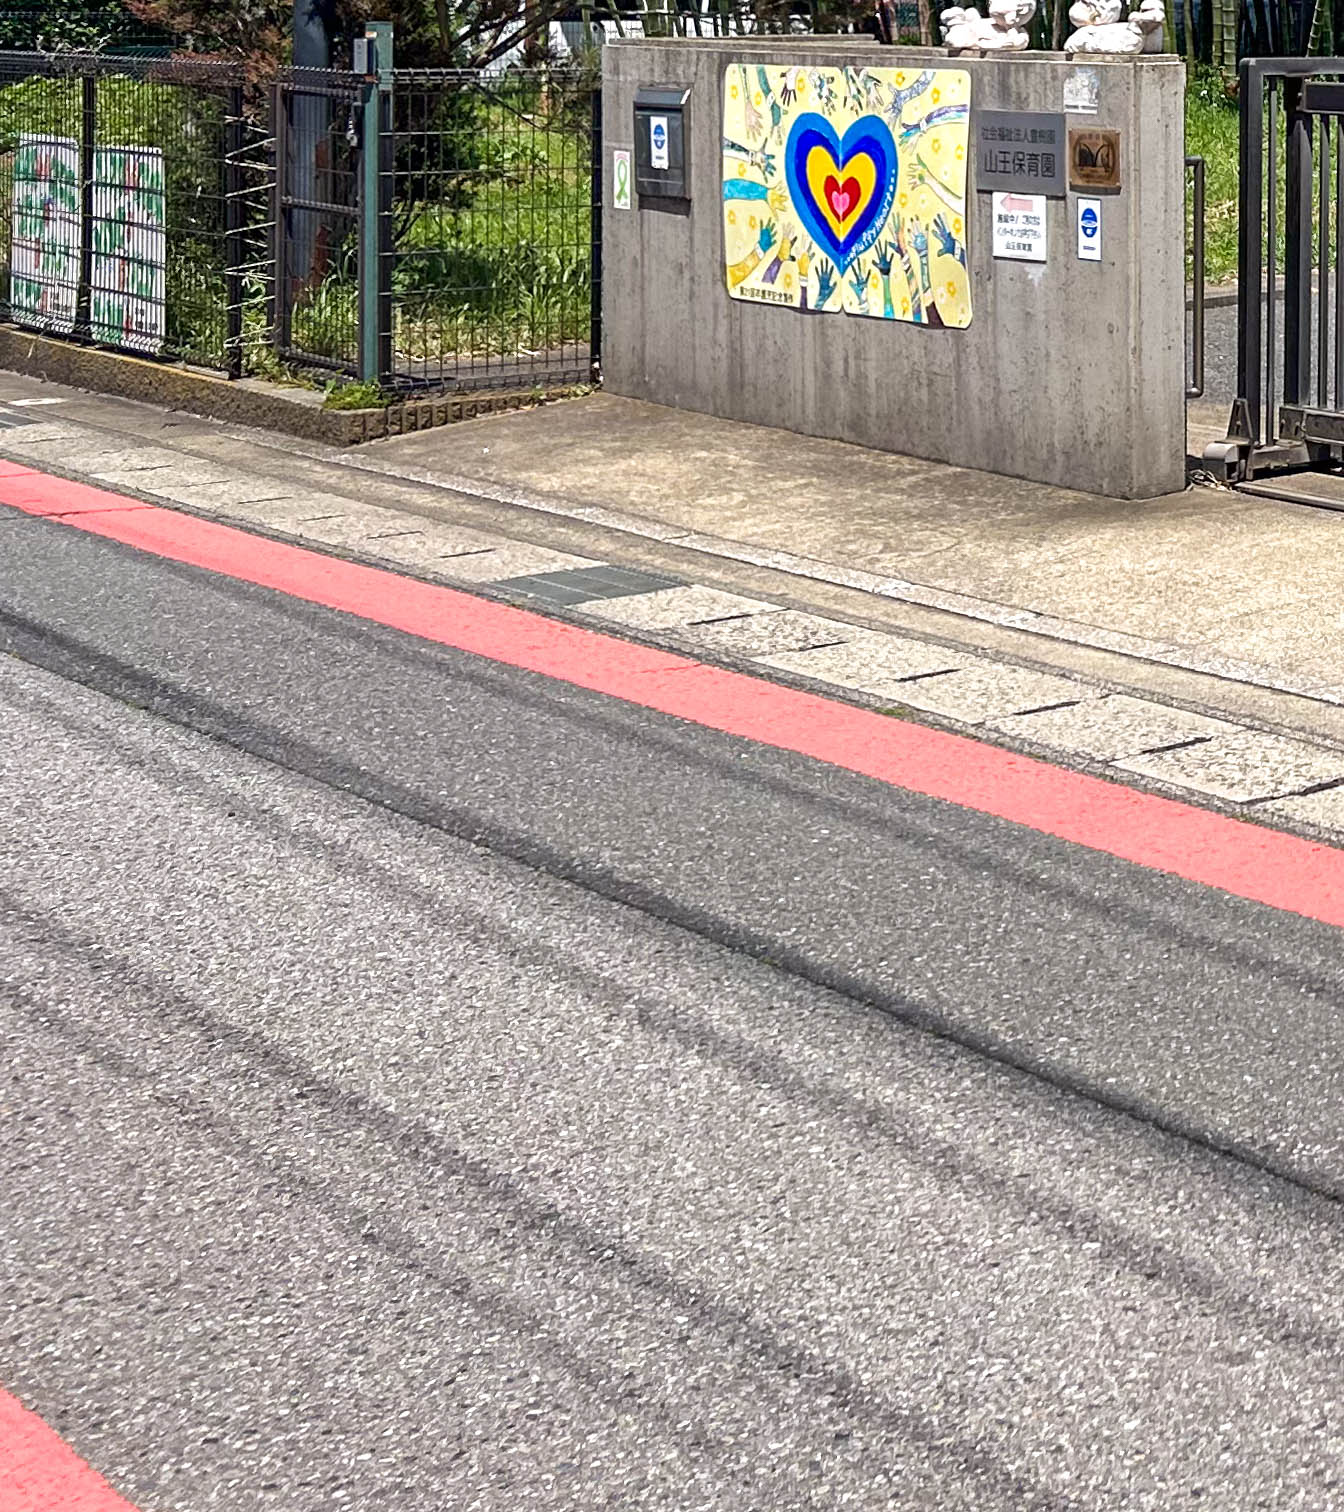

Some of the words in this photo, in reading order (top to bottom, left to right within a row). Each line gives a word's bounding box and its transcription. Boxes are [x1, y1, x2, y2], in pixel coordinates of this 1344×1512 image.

[984, 149, 1055, 178] 山王保育園
